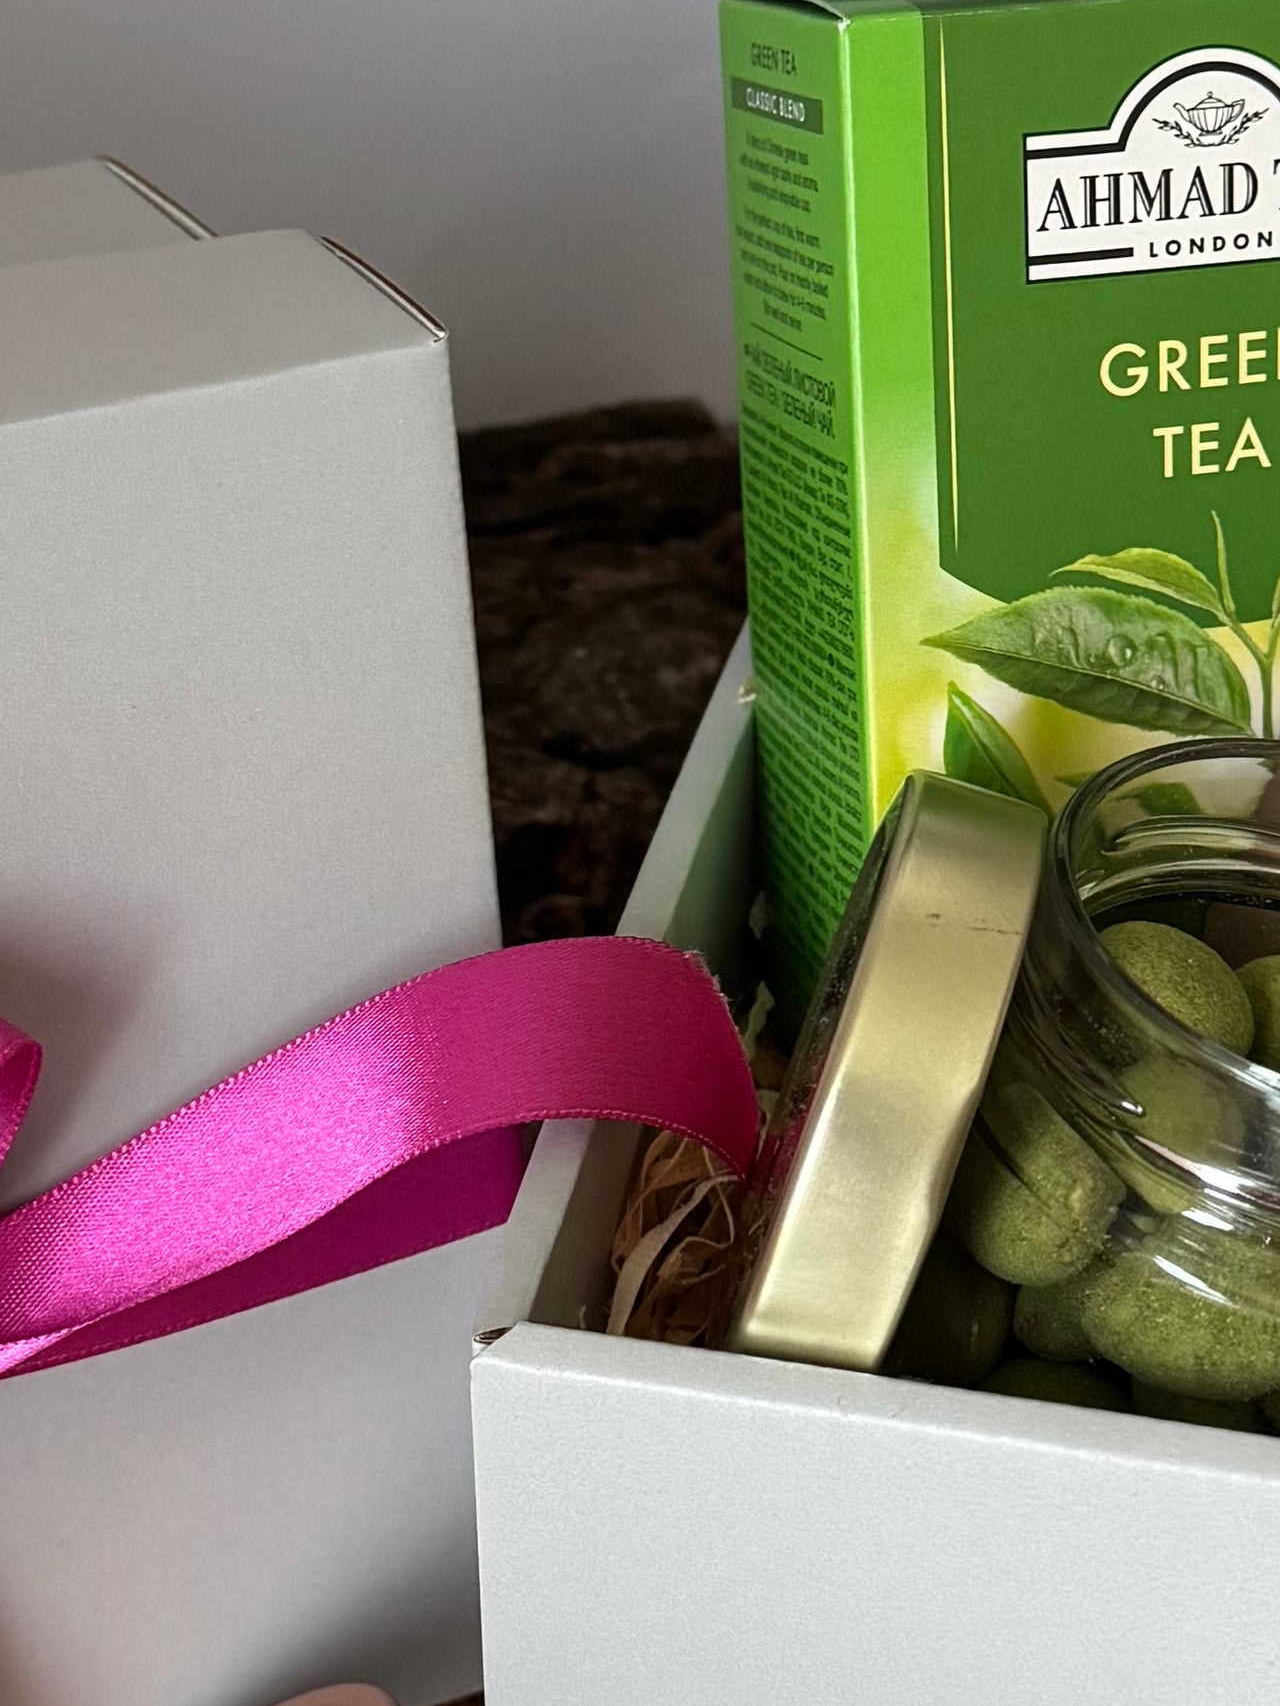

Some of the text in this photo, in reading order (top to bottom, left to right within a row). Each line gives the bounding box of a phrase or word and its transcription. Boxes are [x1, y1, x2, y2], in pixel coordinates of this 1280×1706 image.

[751, 43, 797, 76] GREEN TEA
[746, 87, 806, 123] CLASSIC BLEND
[1035, 161, 1259, 233] AHMAD
[1149, 231, 1274, 258] LONDON
[1153, 417, 1272, 478] TEA
